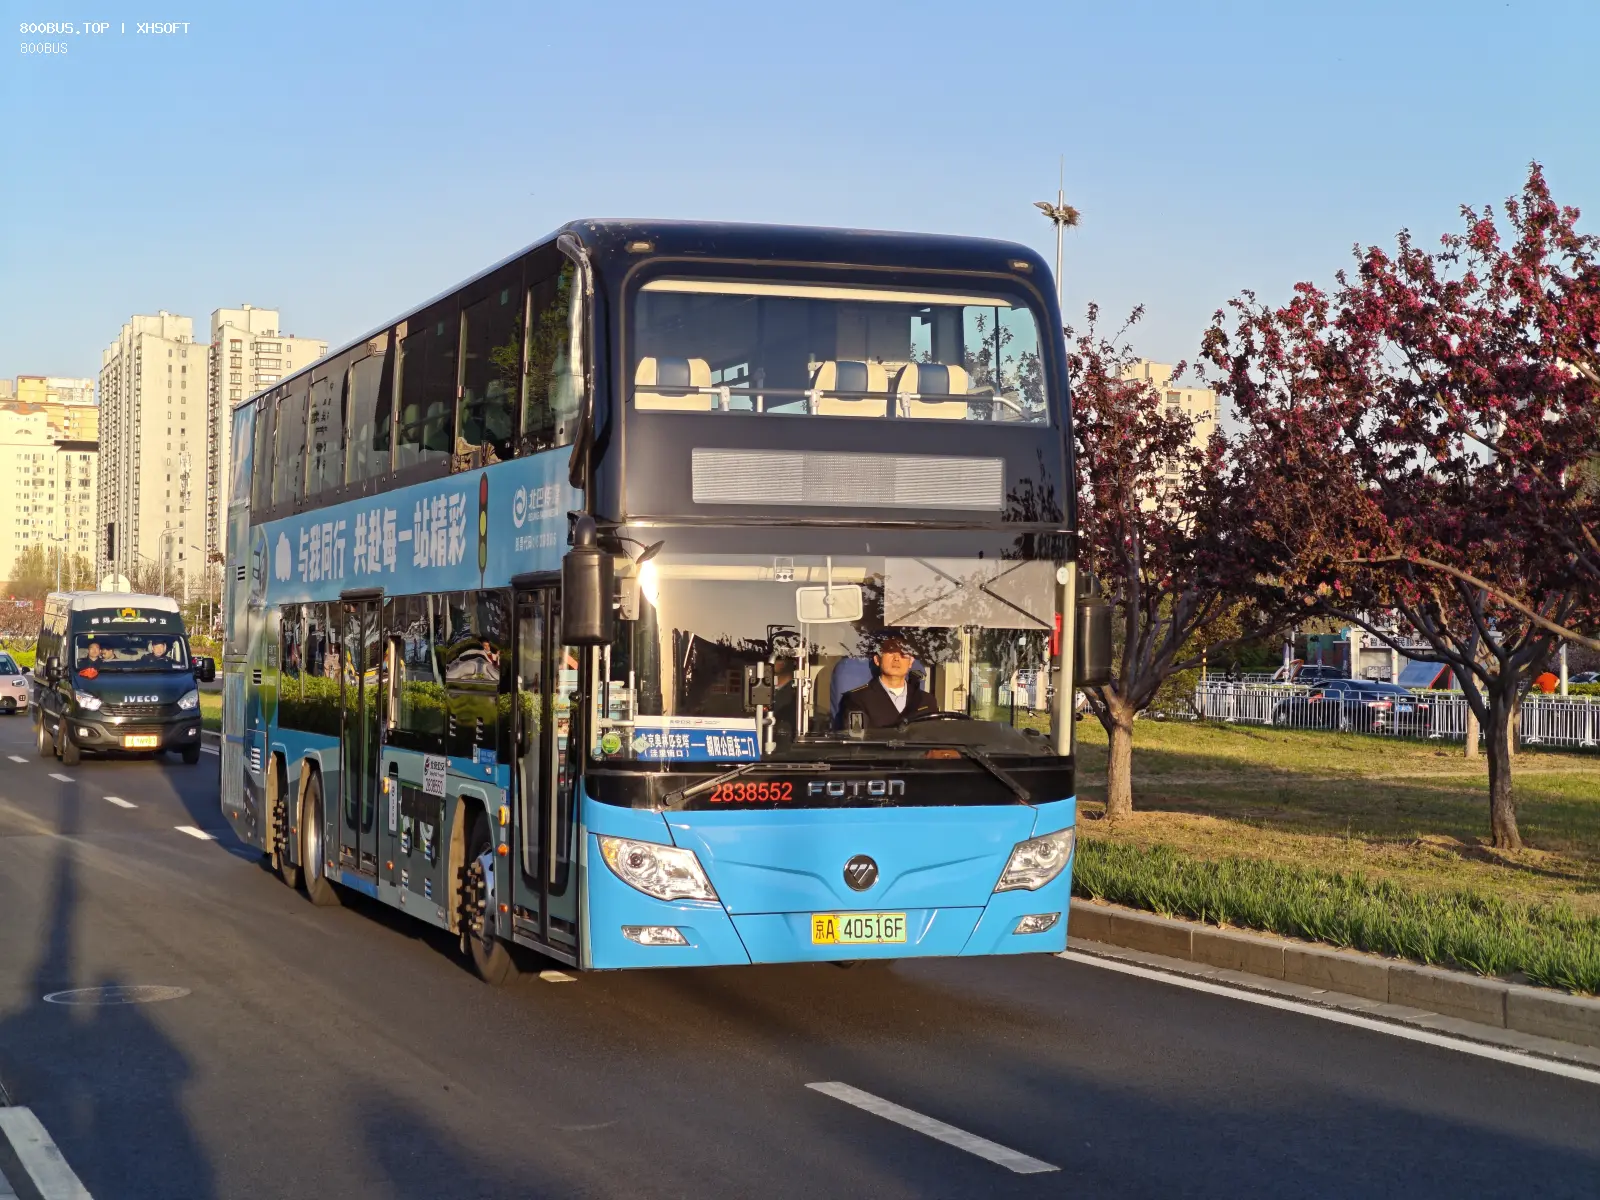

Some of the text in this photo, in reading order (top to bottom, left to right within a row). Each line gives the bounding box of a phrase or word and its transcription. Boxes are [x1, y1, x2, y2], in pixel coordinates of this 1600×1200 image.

[298, 492, 466, 582] 与我同行 共赴每一站精彩
[124, 695, 159, 703] IVECO
[710, 779, 905, 802] 2838552 FOTON
[815, 918, 903, 940] 京A 40516F
